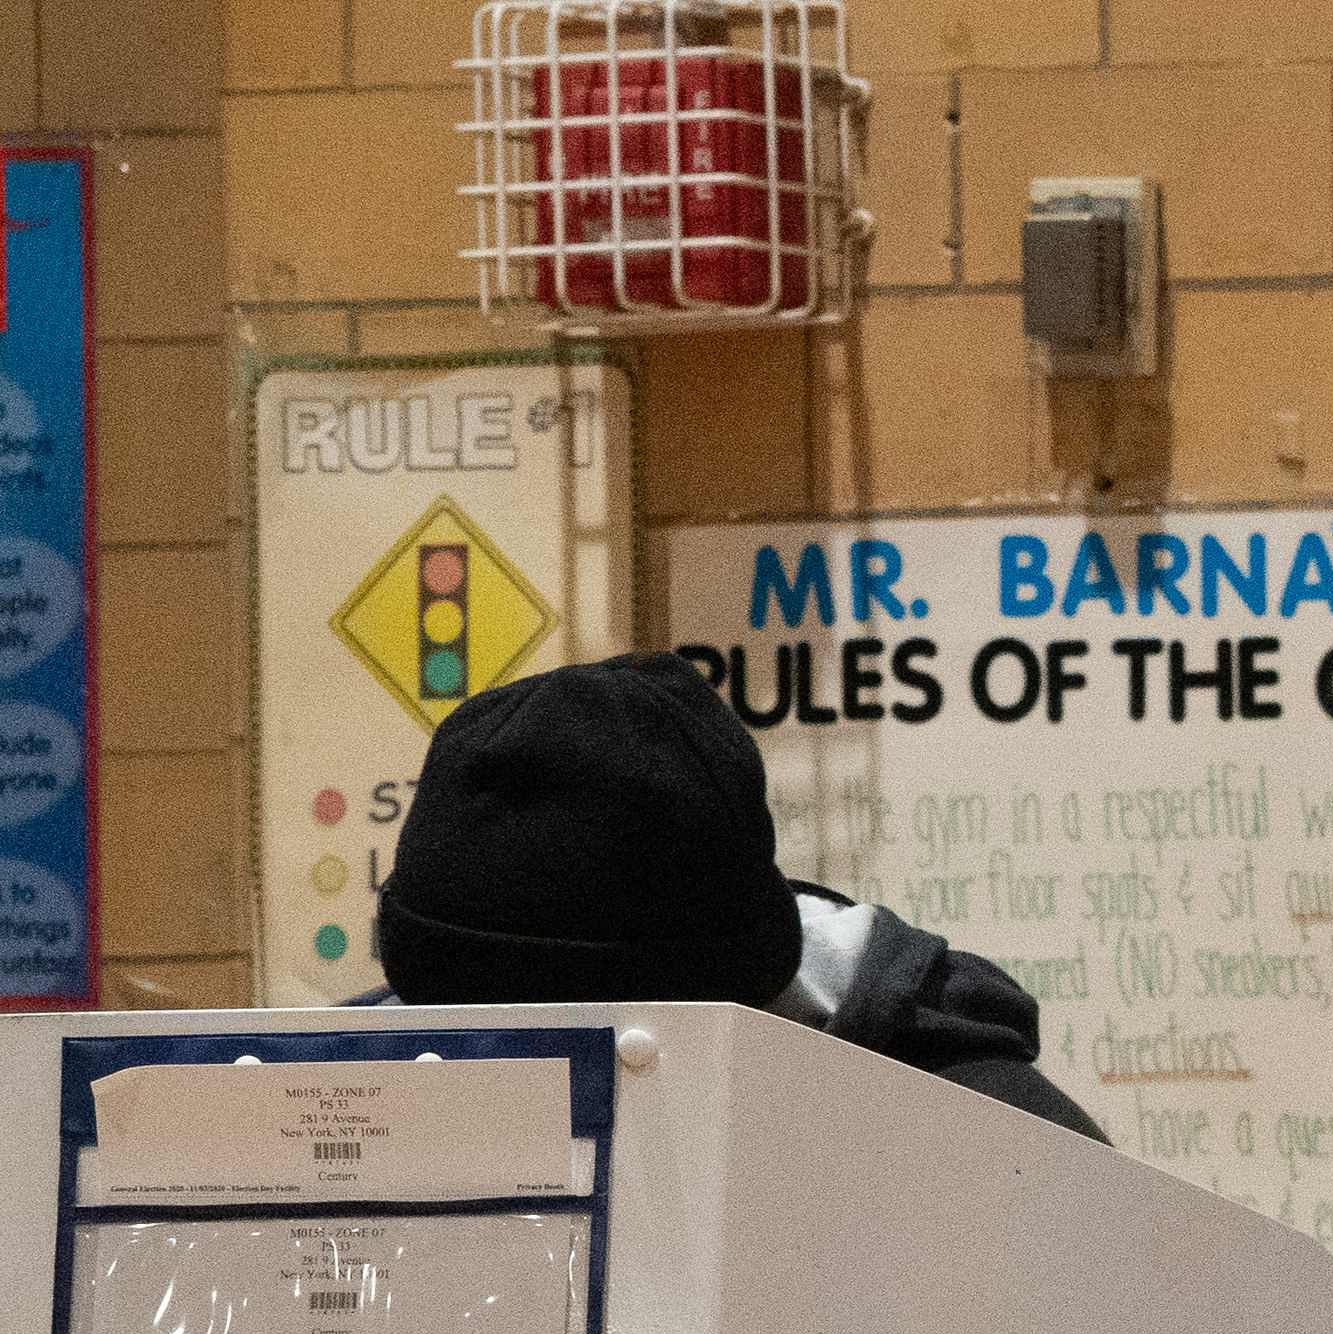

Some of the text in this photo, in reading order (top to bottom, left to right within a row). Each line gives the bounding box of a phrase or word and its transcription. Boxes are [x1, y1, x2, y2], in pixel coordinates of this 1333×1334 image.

[280, 392, 519, 474] RULE
[750, 539, 929, 629] MR.
[970, 636, 1088, 723] OF
[1113, 636, 1282, 724] THE
[911, 791, 988, 869] gym
[1011, 784, 1043, 844] in
[1060, 789, 1082, 843] a
[1102, 762, 1271, 868] respectful
[904, 873, 974, 925] your
[987, 848, 1064, 922] floor
[1081, 851, 1160, 944] spots
[1216, 849, 1258, 924] sit
[285, 1087, 381, 1098] M0155 ZONE 07
[320, 1100, 349, 1110] PS 33
[280, 1127, 389, 1138] New York, NY 10001
[300, 1114, 371, 1124] 281 9 Avenue
[1133, 1089, 1212, 1160] have
[1234, 1110, 1256, 1158] a
[318, 1171, 358, 1181] Century
[371, 1227, 385, 1237] 07
